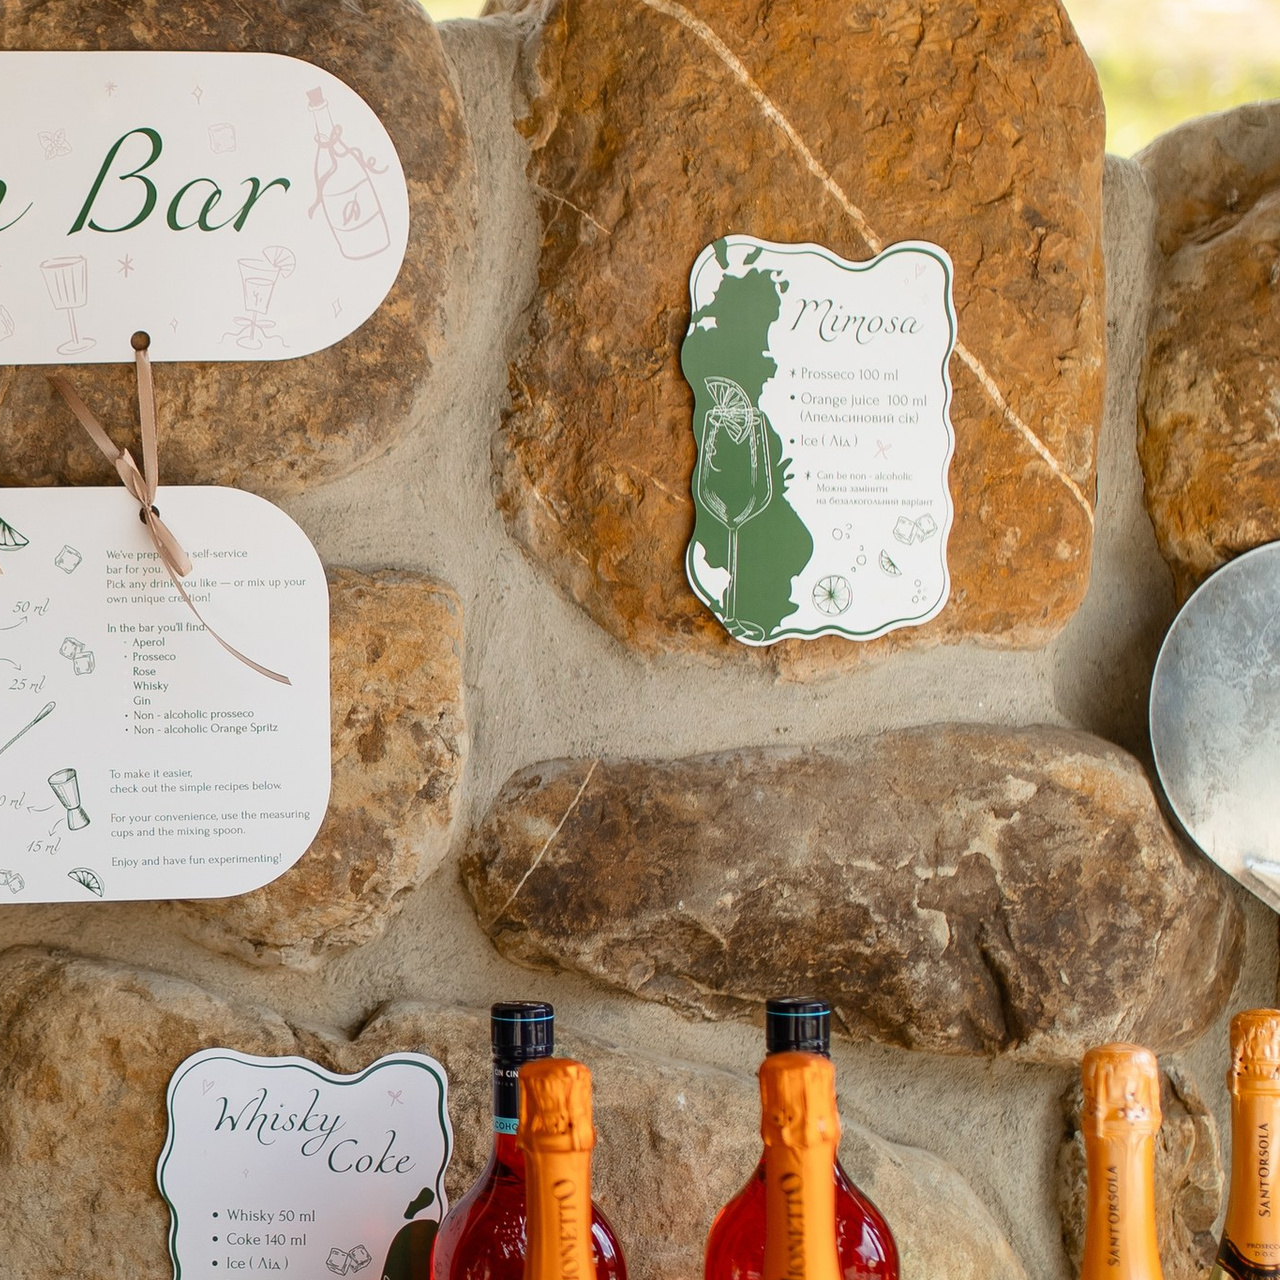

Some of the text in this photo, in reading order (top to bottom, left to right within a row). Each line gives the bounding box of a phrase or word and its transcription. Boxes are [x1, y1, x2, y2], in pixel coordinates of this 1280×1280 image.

[67, 127, 290, 236] Bar
[790, 298, 923, 345] Mimosa
[801, 366, 898, 381] Prosseco 100 ml
[800, 391, 927, 409] Orange juice 100 ml
[800, 410, 919, 424] (Апельсиновий сік)
[106, 564, 166, 576] bar for you.
[12, 597, 50, 617] 50 ml
[107, 623, 117, 633] In
[119, 623, 136, 633] the
[138, 623, 155, 633] bar
[157, 622, 183, 635] you'll
[132, 637, 165, 650] Aperol
[132, 651, 177, 662] Prosseco
[133, 666, 156, 676] Rose
[8, 674, 46, 694] 25 ml
[133, 680, 169, 693] Whisky
[133, 695, 151, 706] Gin
[109, 768, 193, 779] To make it easier,
[109, 780, 282, 794] check out the simple recipes below.
[9, 791, 28, 810] ml
[110, 809, 310, 825] For your convenience, use the measuring
[110, 826, 246, 840] cups and the mixing spoon.
[26, 836, 62, 856] 15 ml
[111, 852, 282, 869] Enjoy and have fun experimenting!
[214, 1087, 347, 1157] Whisky
[327, 1130, 416, 1174] Coke
[226, 1208, 315, 1225] Whisky 50 ml
[226, 1232, 306, 1246] Coke 140 ml
